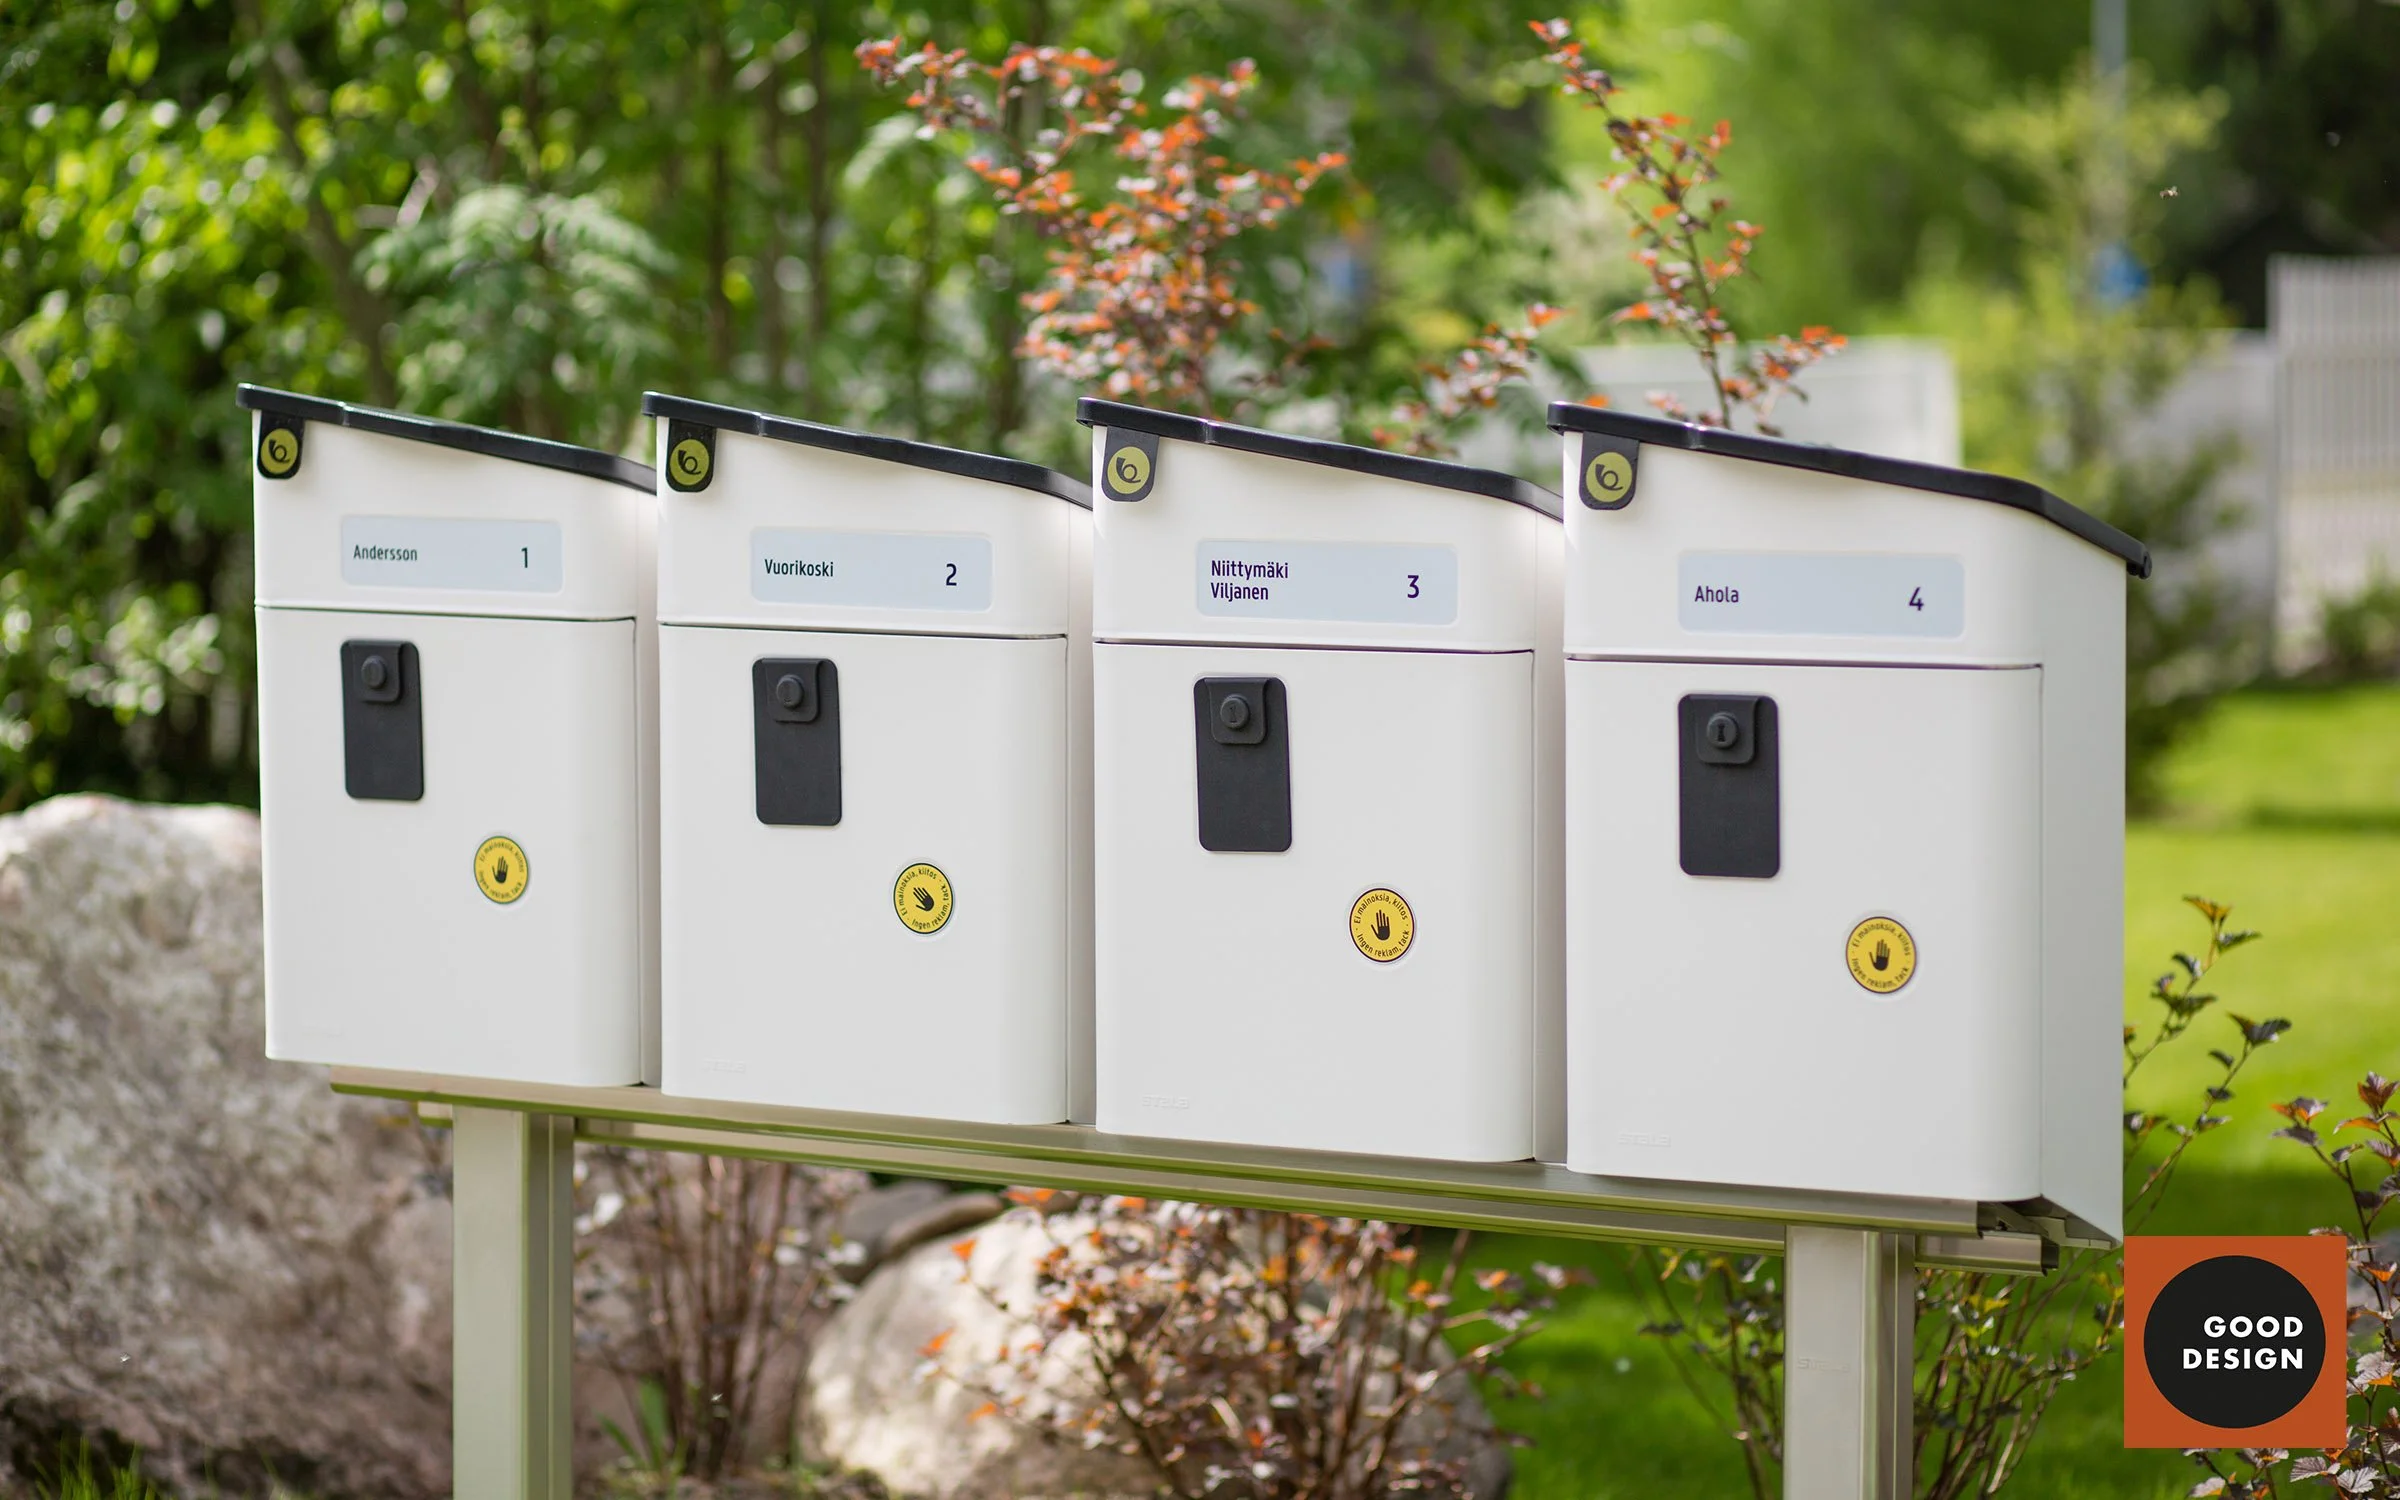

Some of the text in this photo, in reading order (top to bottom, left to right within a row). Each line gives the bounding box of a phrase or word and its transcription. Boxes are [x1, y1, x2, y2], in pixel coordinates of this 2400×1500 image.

[353, 544, 418, 562] Andersson
[520, 547, 529, 569] 1
[764, 558, 835, 577] Vuorikoski
[945, 563, 958, 586] 2
[1211, 560, 1289, 580] Niittymäki
[1210, 582, 1269, 602] Viljanen
[1407, 574, 1420, 599] 3
[1694, 585, 1740, 603] Ahola
[1908, 587, 1924, 611] 4
[918, 867, 938, 880] kiitos
[1391, 898, 1409, 921] kiitos
[1397, 930, 1410, 947] tack
